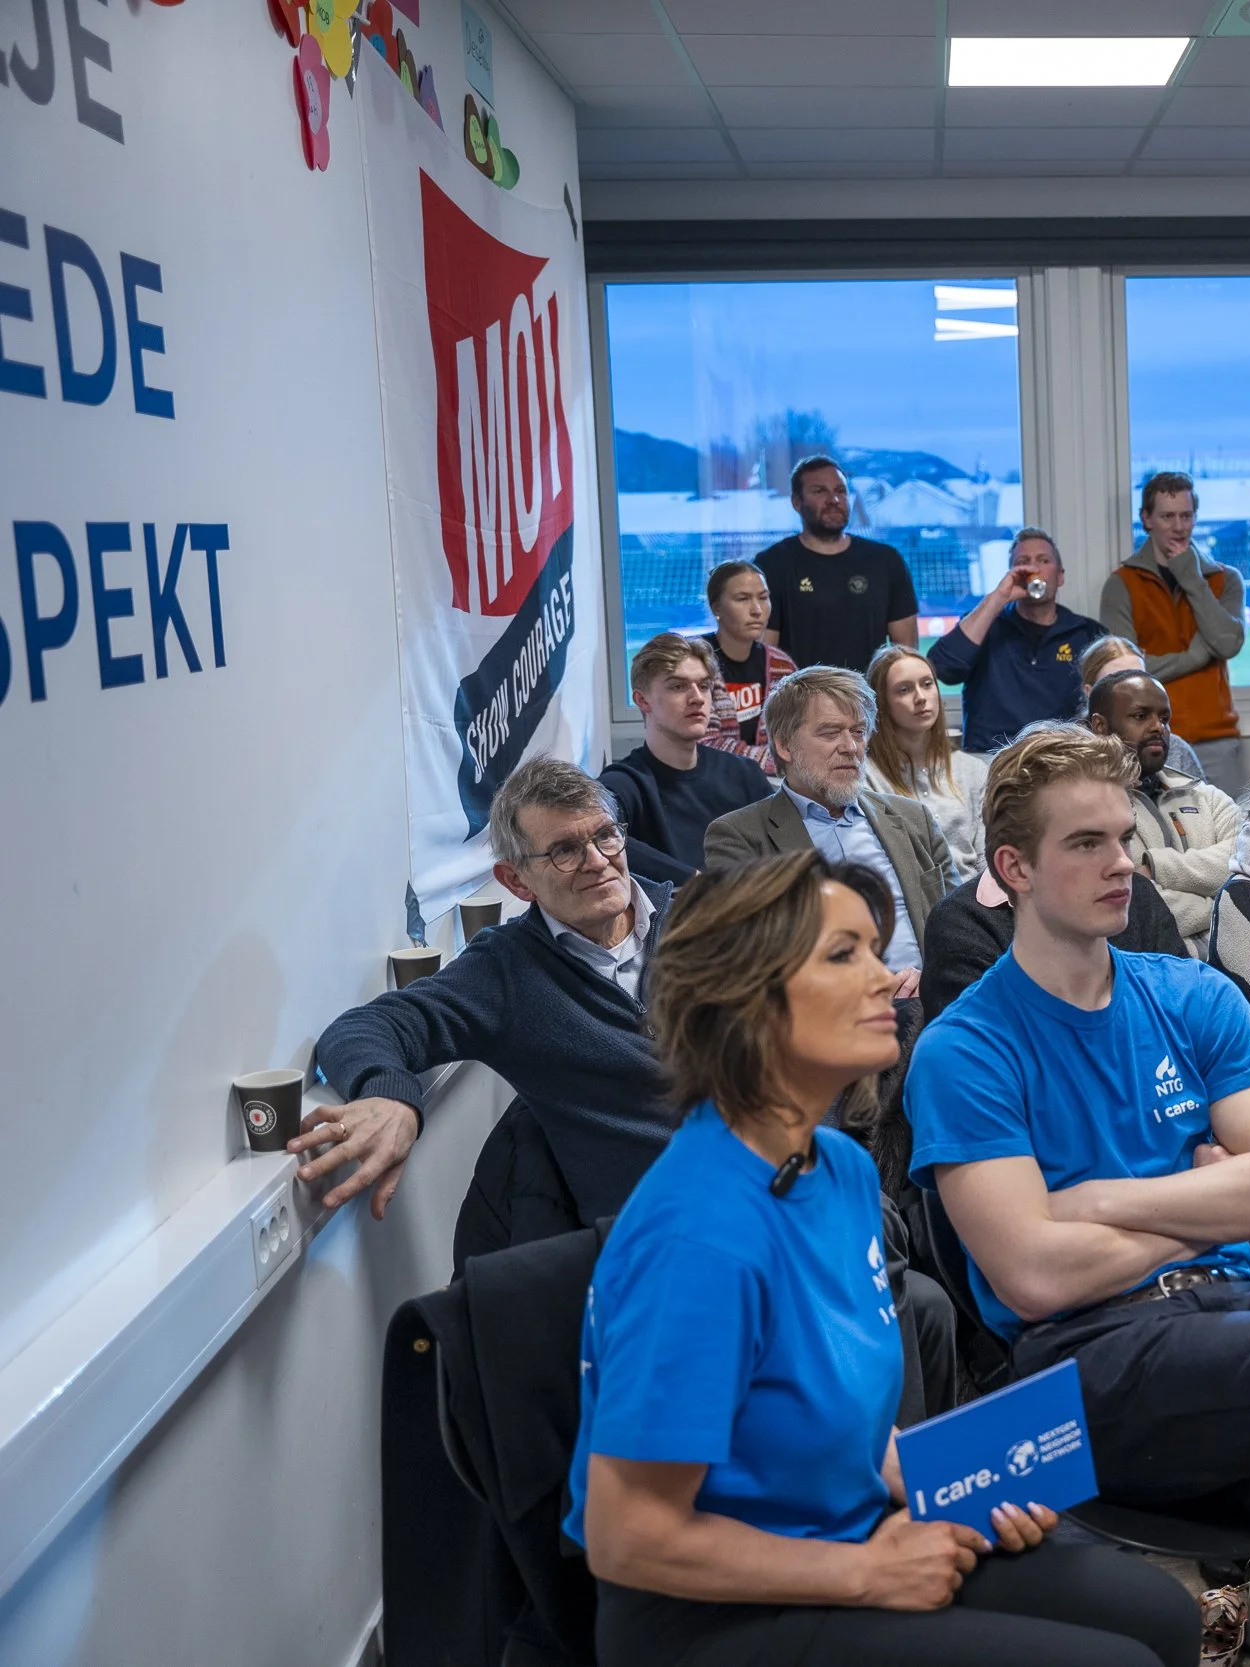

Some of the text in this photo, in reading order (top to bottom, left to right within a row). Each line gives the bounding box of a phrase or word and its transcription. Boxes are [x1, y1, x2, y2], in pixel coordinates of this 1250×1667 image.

[0, 0, 125, 145] JE
[456, 262, 563, 616] MOT
[1056, 653, 1073, 662] NTG
[466, 571, 571, 784] SHOW COURAGE
[1155, 1077, 1184, 1098] NTG
[1153, 1099, 1200, 1123] I care.
[1037, 1418, 1078, 1443] NEXTGEN
[1039, 1427, 1082, 1454] NEIGHBOR
[1040, 1438, 1082, 1465] NETWORK
[915, 1468, 1001, 1517] I care.
